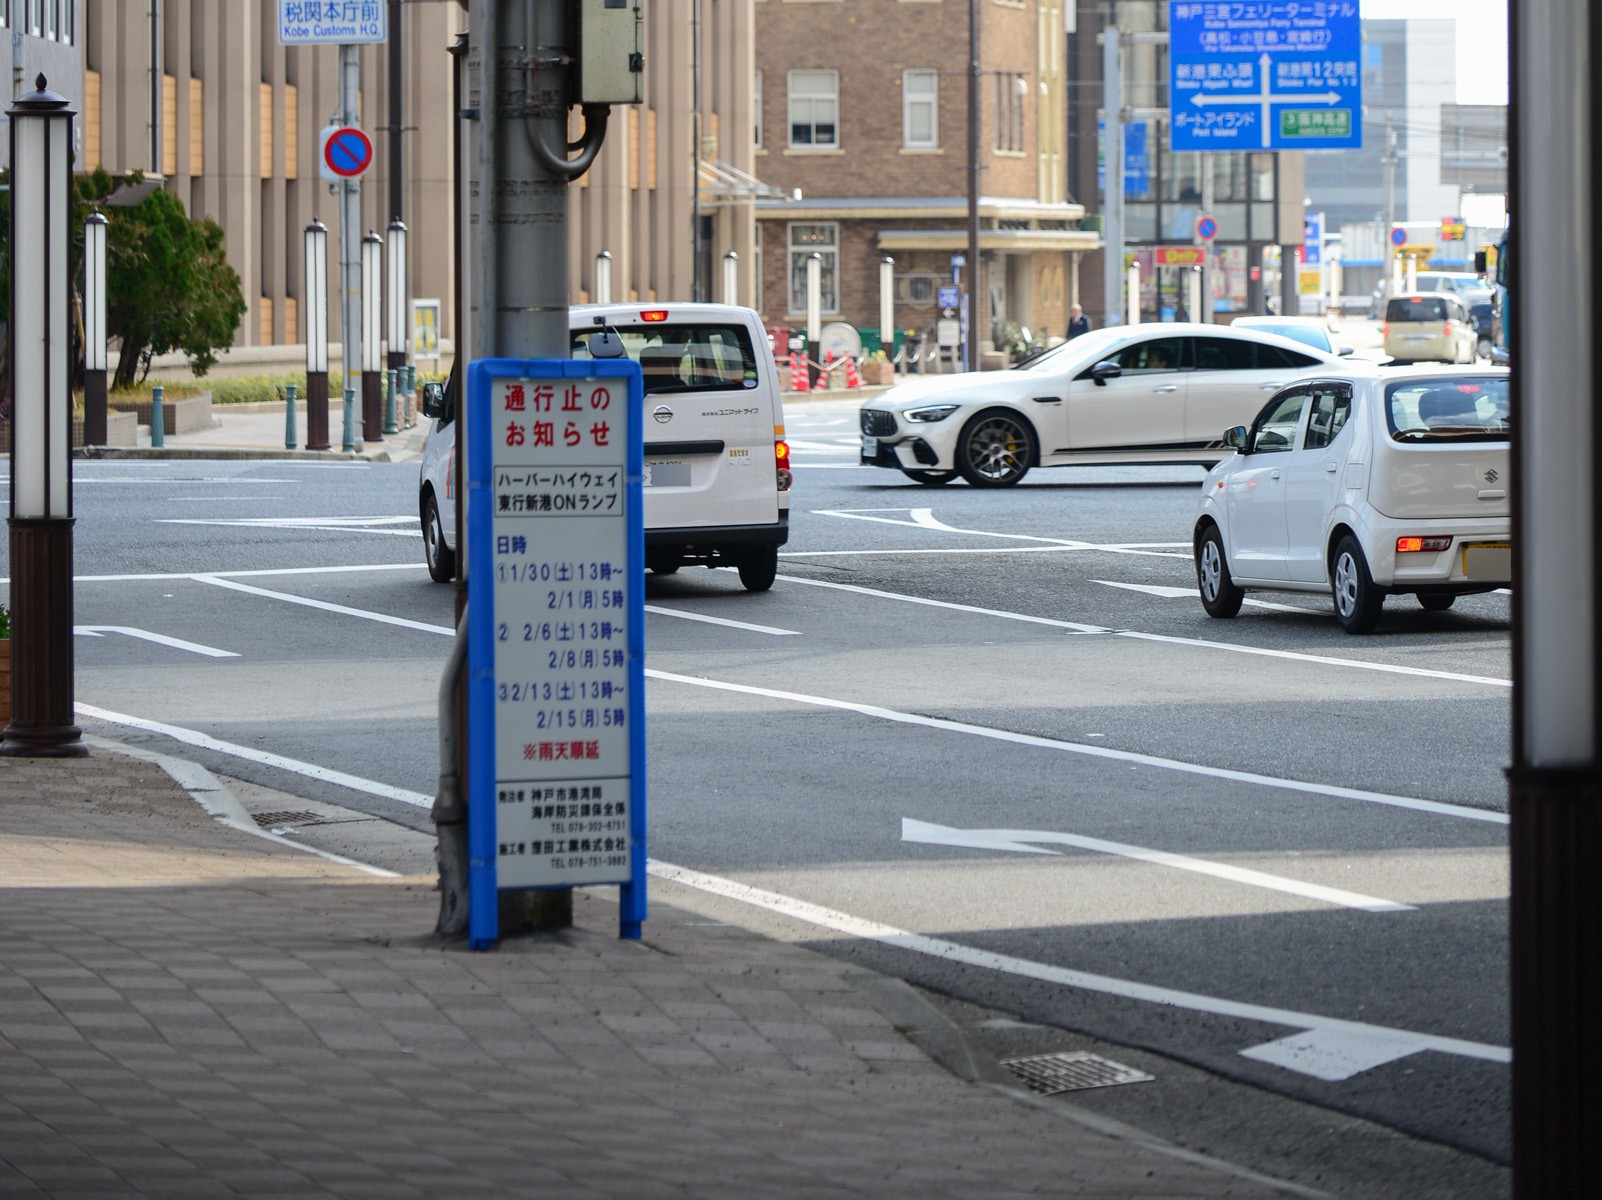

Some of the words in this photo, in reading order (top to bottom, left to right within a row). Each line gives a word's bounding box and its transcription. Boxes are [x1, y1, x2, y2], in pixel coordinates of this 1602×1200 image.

[285, 0, 380, 23] 税関本庁前
[1176, 2, 1356, 20] 神戸三宮フェリーターミナル
[284, 25, 310, 37] Kobe
[313, 24, 357, 37] Customs
[1175, 111, 1256, 128] ポートアイランド
[504, 384, 611, 413] 通行止の
[505, 420, 610, 448] お知らせ
[498, 472, 618, 488] ハーバーハイウェイ
[498, 493, 618, 511] 東行新港ONランプ
[496, 535, 527, 555] 日時
[522, 739, 601, 763] ※雨天順延
[551, 822, 566, 834] TEL
[551, 857, 566, 870] TEL
